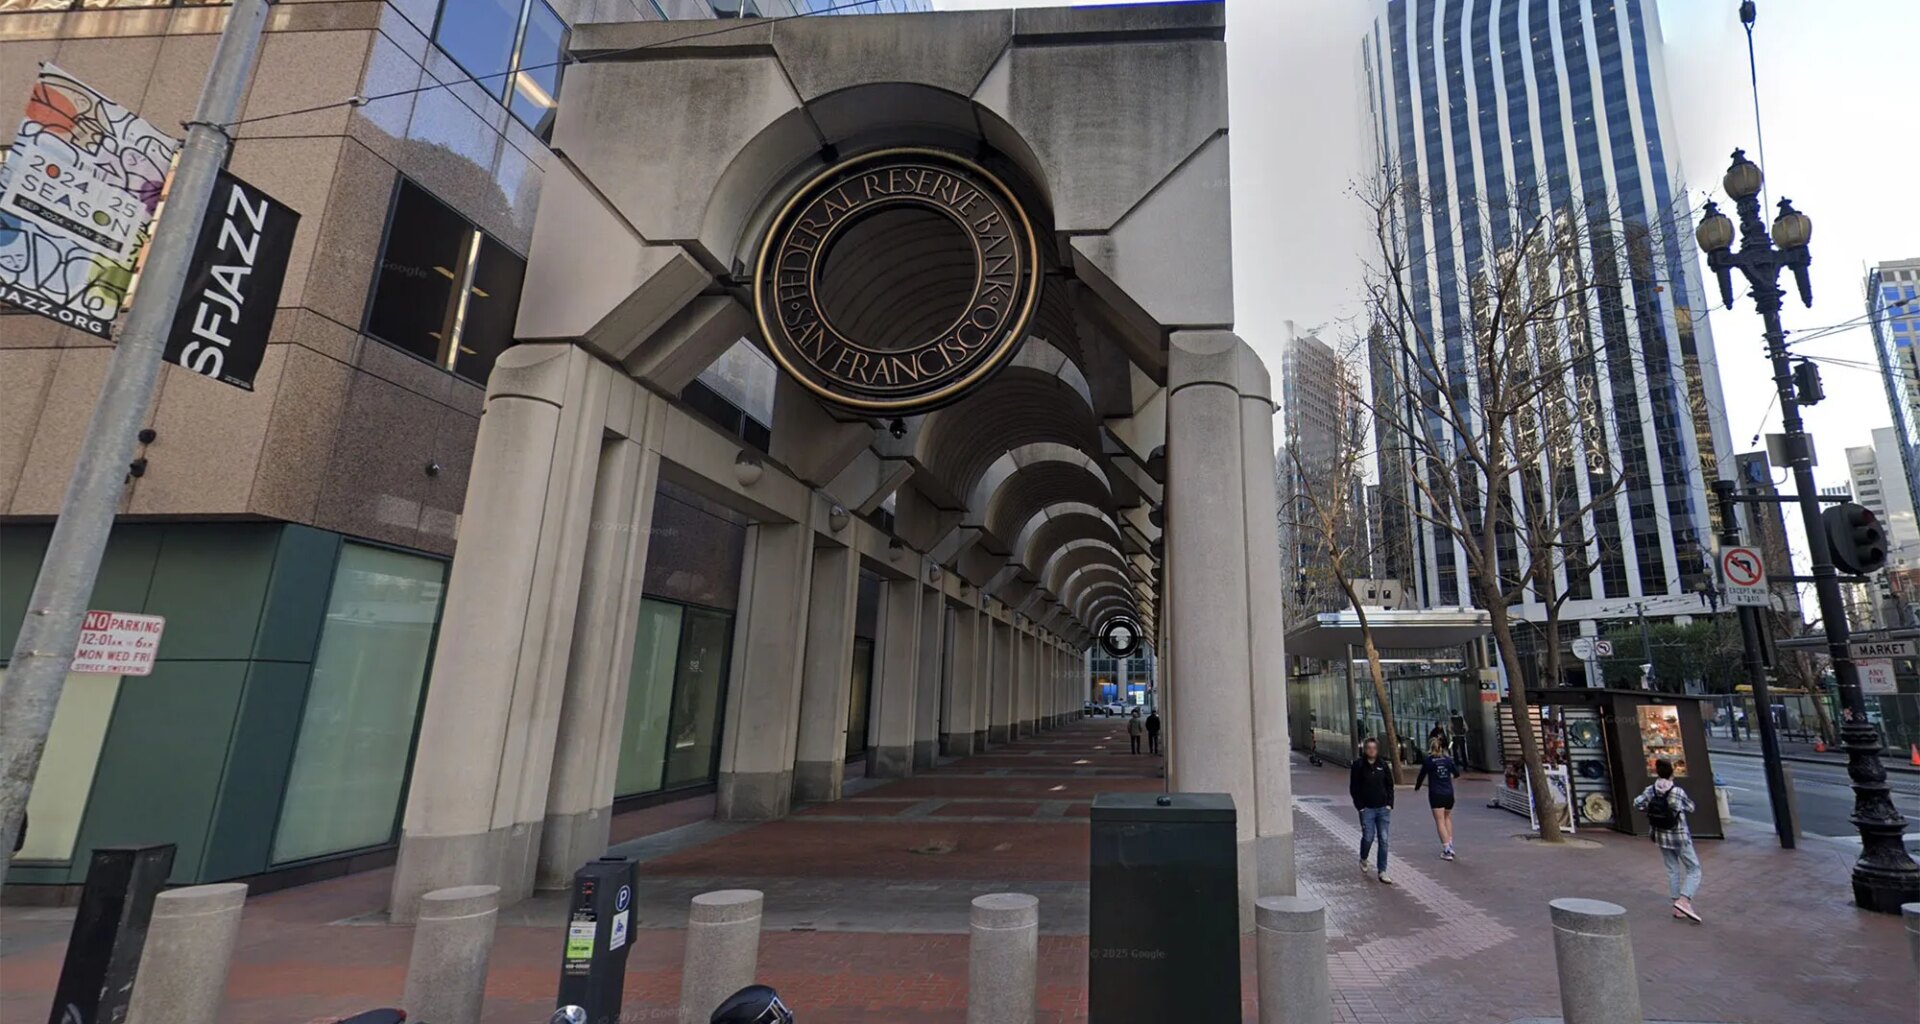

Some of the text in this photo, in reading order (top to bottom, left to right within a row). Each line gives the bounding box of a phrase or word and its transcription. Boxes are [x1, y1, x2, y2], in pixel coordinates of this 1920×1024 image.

[29, 155, 138, 218] 2024 25
[21, 174, 131, 237] SEASON
[19, 198, 40, 212] SEP
[72, 223, 94, 238] MAY
[779, 168, 1014, 302] FEDERAL RESERVE BANK
[180, 183, 269, 379] SFJAZZ
[786, 304, 999, 385] SAN FRANCISCO
[84, 612, 160, 633] NO PARKING
[78, 649, 151, 662] MON WED FRI
[1859, 643, 1906, 656] MARKET
[107, 664, 147, 673] SWEEPING
[1868, 669, 1884, 677] ANY
[1868, 677, 1888, 685] TIME
[619, 889, 628, 909] P
